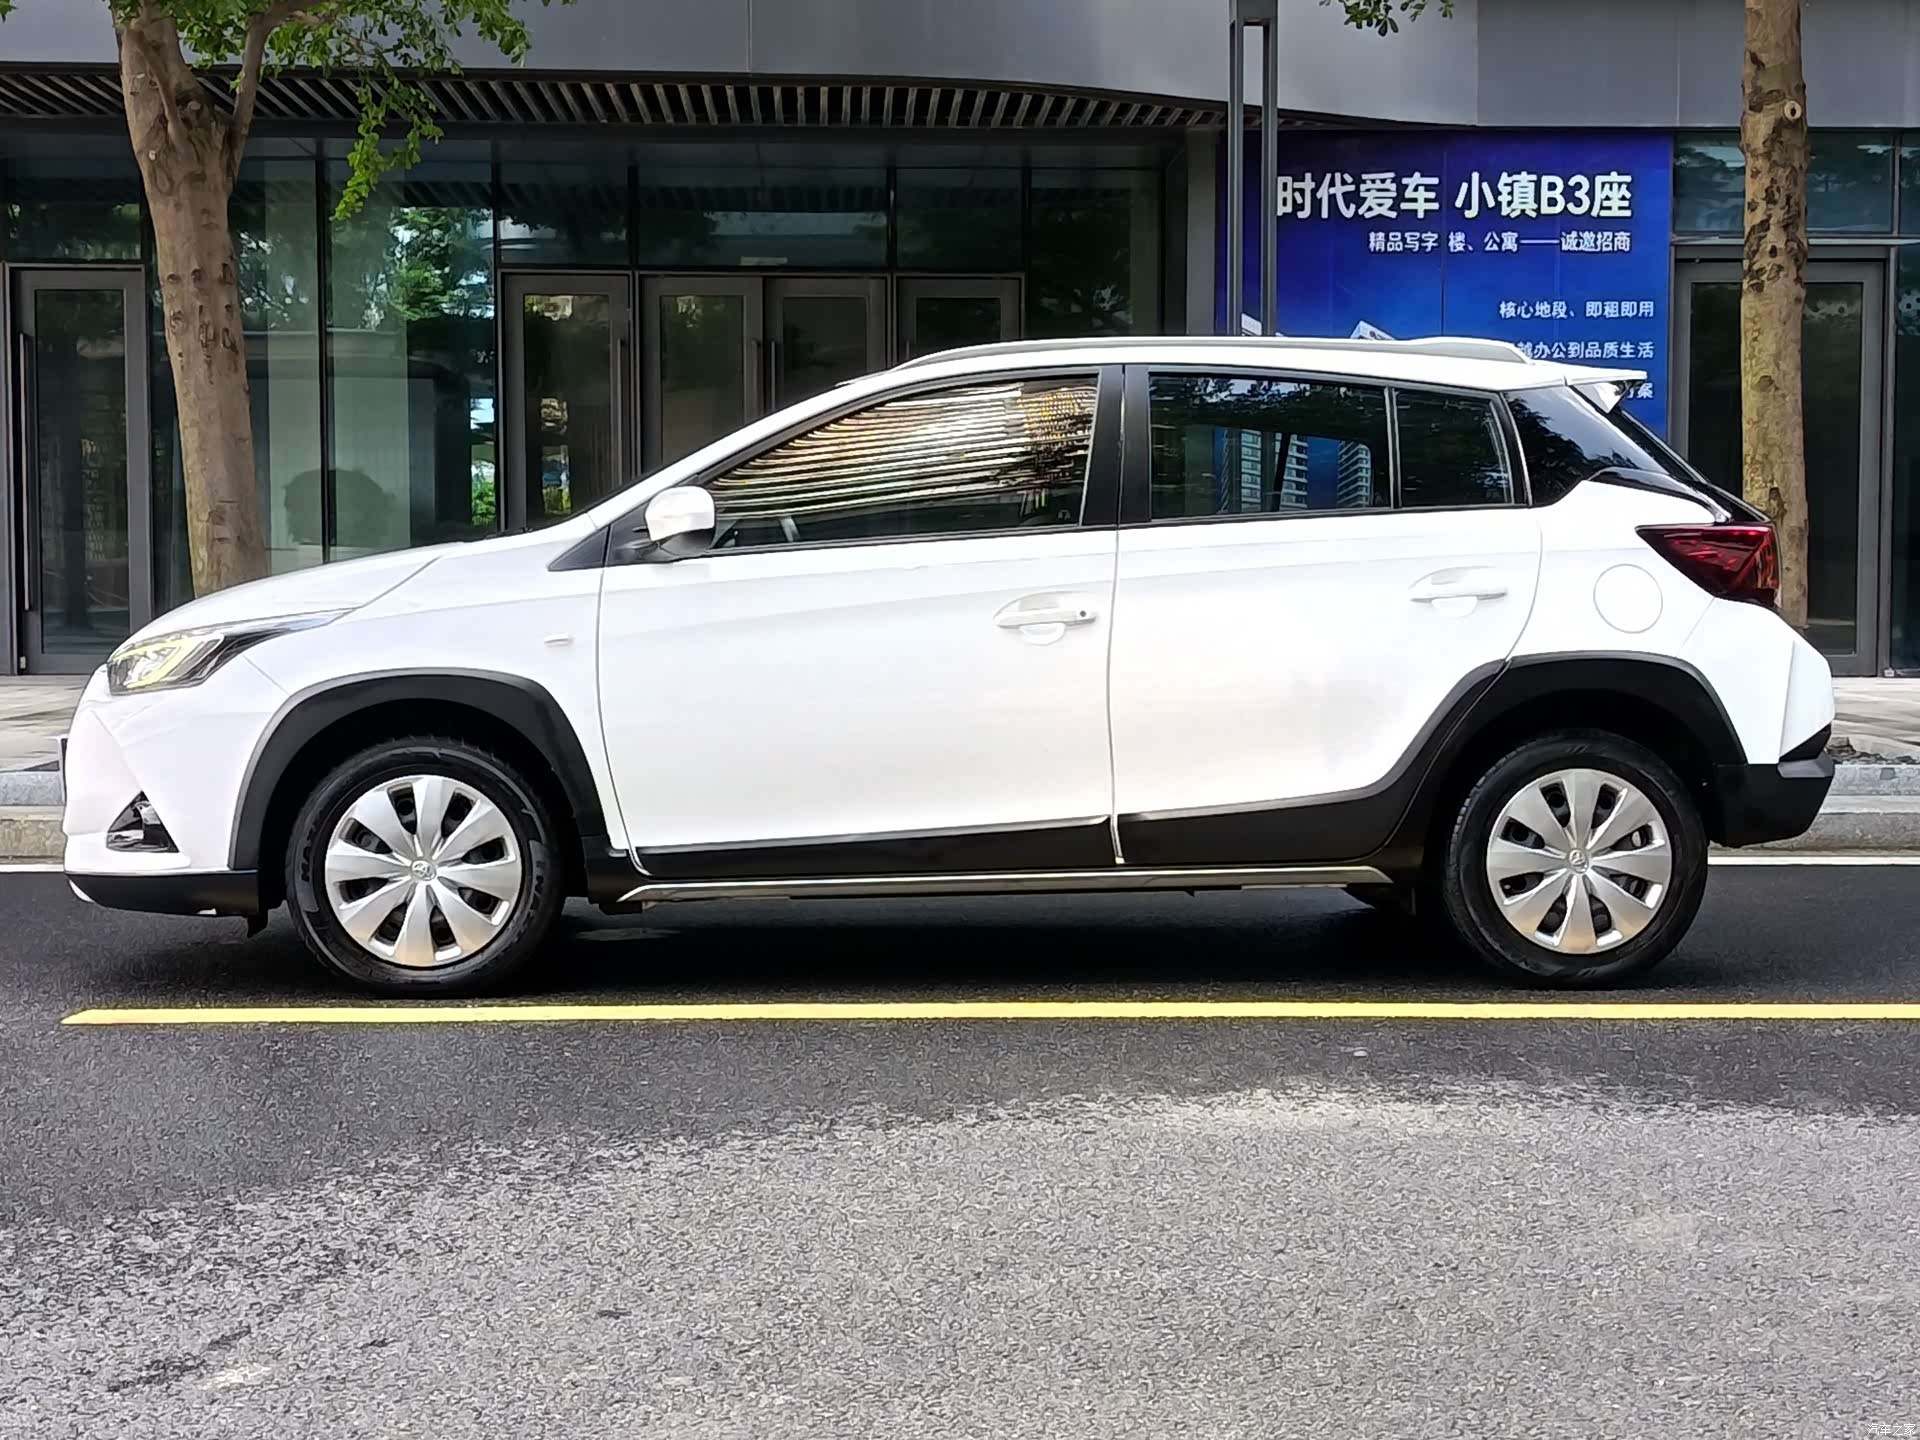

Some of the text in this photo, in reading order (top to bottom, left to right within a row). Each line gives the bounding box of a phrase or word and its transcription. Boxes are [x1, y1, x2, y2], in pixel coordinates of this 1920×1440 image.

[1276, 171, 1632, 219] 时代爱车 小镇B3座
[1368, 231, 1439, 252] 精品写字
[1499, 301, 1654, 319] 核心地段、即租即用
